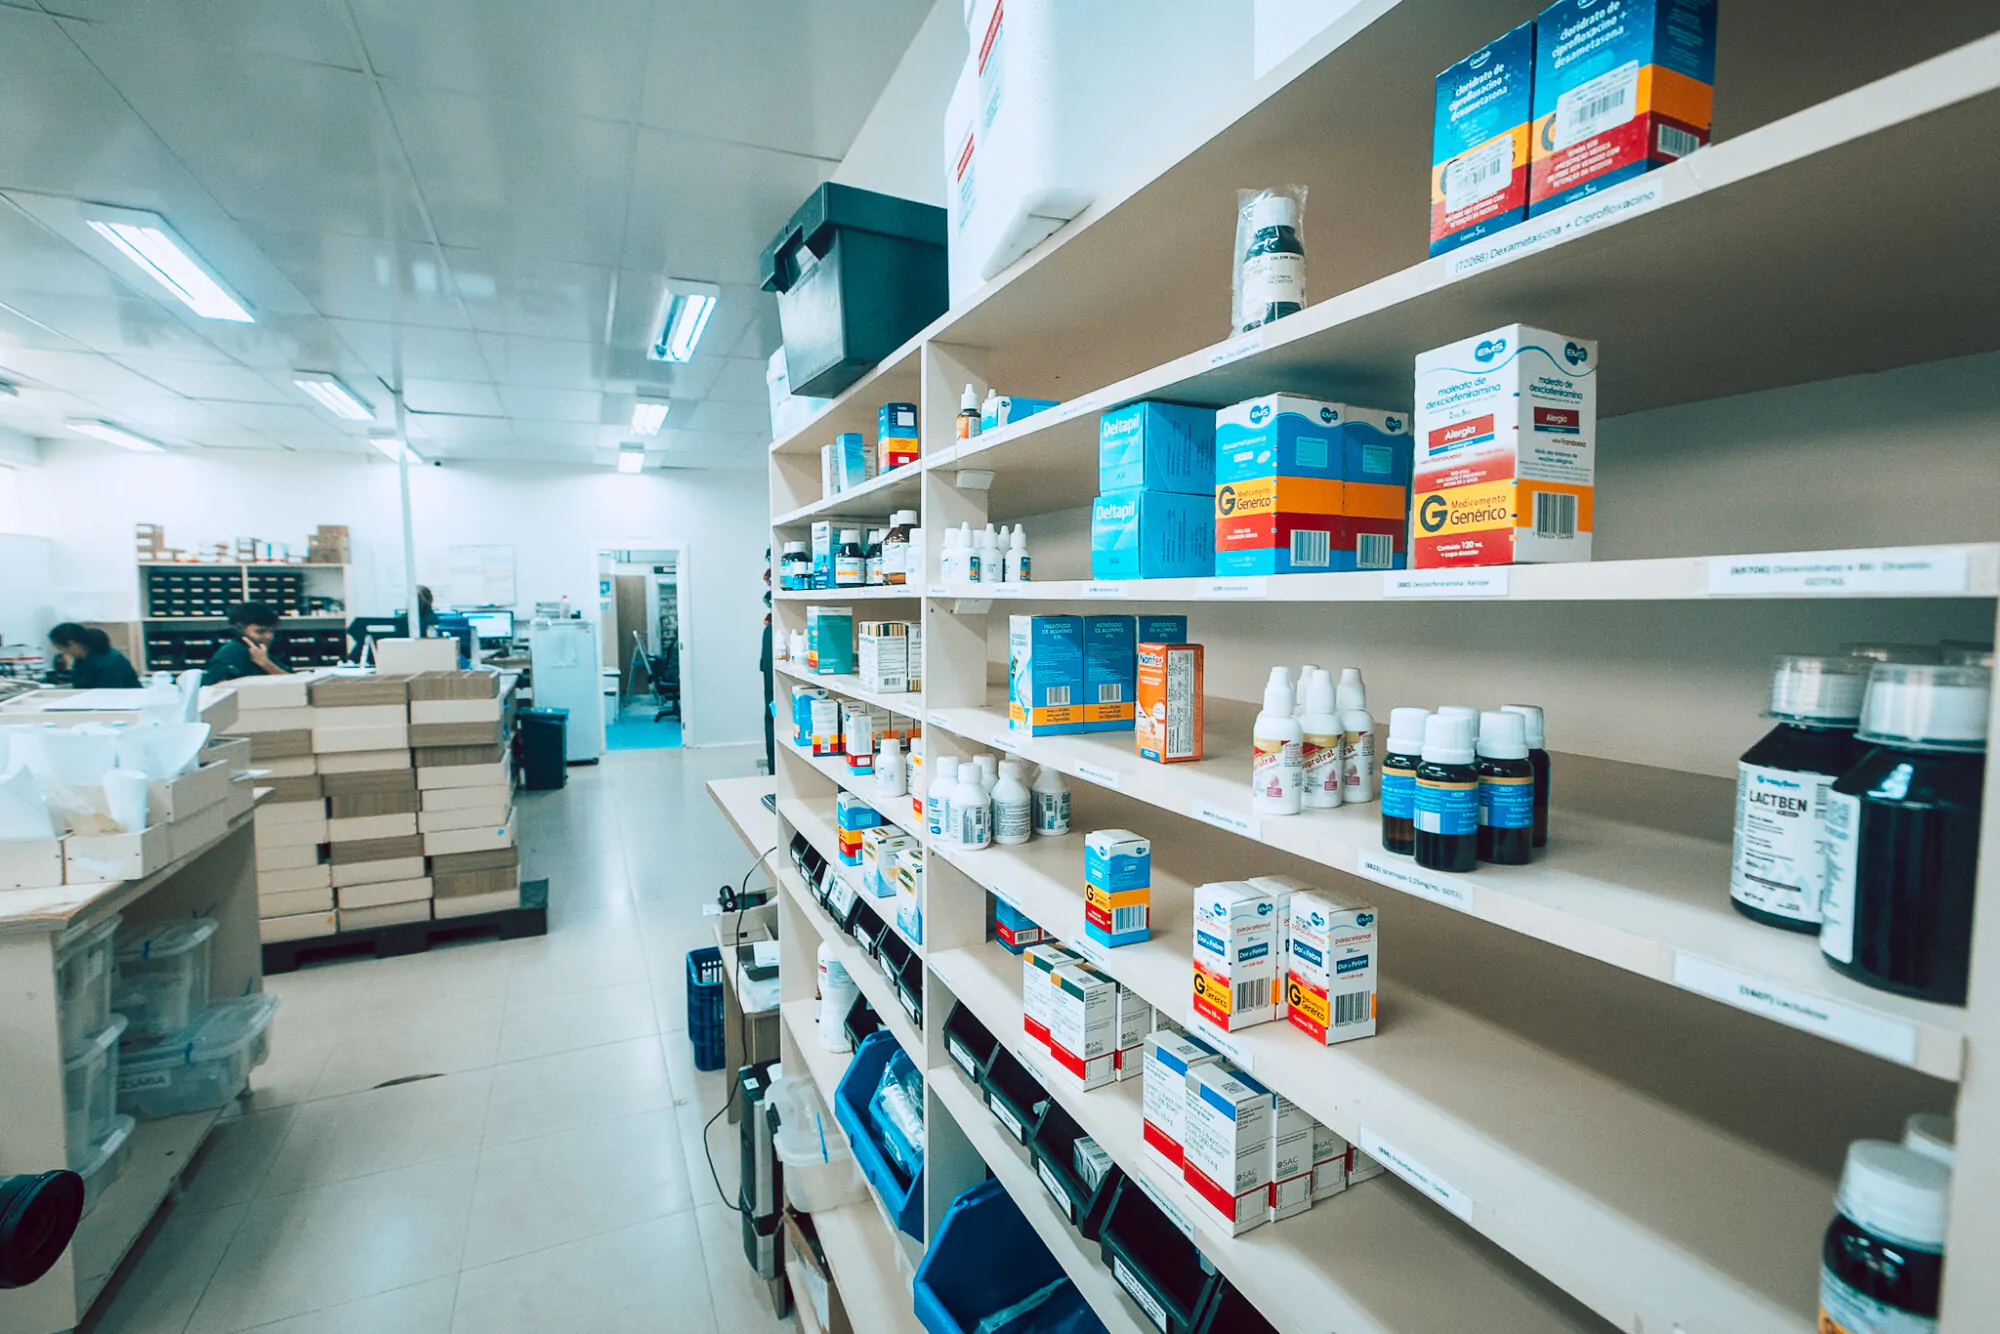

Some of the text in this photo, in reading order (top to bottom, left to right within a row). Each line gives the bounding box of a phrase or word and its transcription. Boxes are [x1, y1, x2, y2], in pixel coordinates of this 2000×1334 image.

[1490, 226, 1561, 259] Dexametasona
[1574, 191, 1655, 228] Ciprofloxacino
[1477, 342, 1503, 357] EMS
[1566, 348, 1584, 358] EMS
[1438, 377, 1486, 396] maleato de
[1539, 376, 1573, 389] maleato de
[1251, 409, 1269, 419] EMS
[1321, 411, 1337, 419] EMS
[1546, 413, 1567, 424] Alergia
[1103, 413, 1140, 437] Deltapil
[1444, 425, 1476, 440] Alergia
[1218, 486, 1236, 516] G
[1236, 496, 1271, 510] Genérico
[1451, 495, 1507, 509] Medicamento
[1096, 501, 1135, 521] Deltapil
[1420, 494, 1448, 533] G
[1450, 504, 1507, 525] Genérico
[1749, 790, 1808, 812] LACTBEN
[1236, 922, 1272, 934] paracetamol
[1335, 932, 1372, 945] paracetamol
[1210, 940, 1224, 952] Febre
[1252, 947, 1267, 955] Febre
[1294, 943, 1303, 954] Dor
[1306, 949, 1321, 963] Febre
[1351, 959, 1368, 967] Febre
[1194, 973, 1205, 994] G
[1206, 989, 1227, 1008] Genérico
[1290, 984, 1301, 1006] G
[1302, 1000, 1325, 1021] Genérico
[1126, 1030, 1138, 1038] SAC
[1319, 1139, 1333, 1148] SAC
[1282, 1156, 1298, 1166] SAC
[1242, 1168, 1257, 1179] SAC
